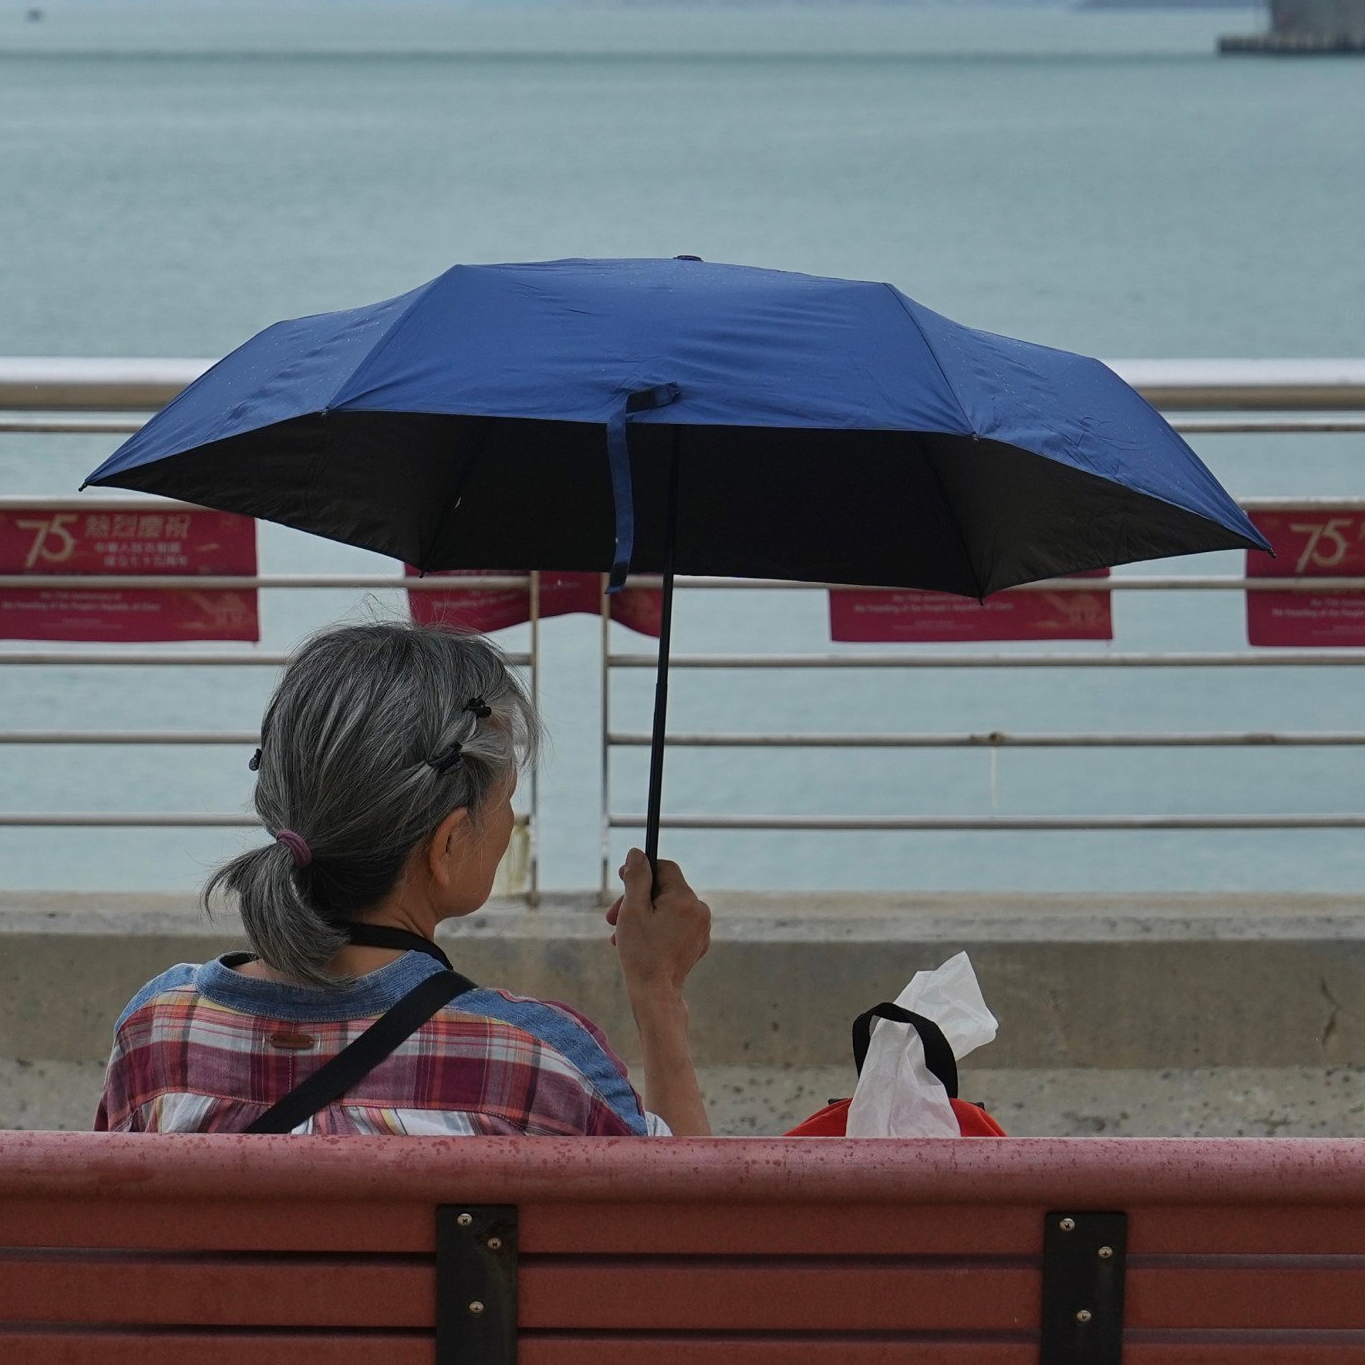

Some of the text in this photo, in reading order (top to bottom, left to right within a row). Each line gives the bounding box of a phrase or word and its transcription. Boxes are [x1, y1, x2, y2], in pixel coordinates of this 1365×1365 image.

[16, 514, 79, 569] 75
[85, 514, 192, 540] 熱烈慶祝
[1289, 518, 1354, 574] 75
